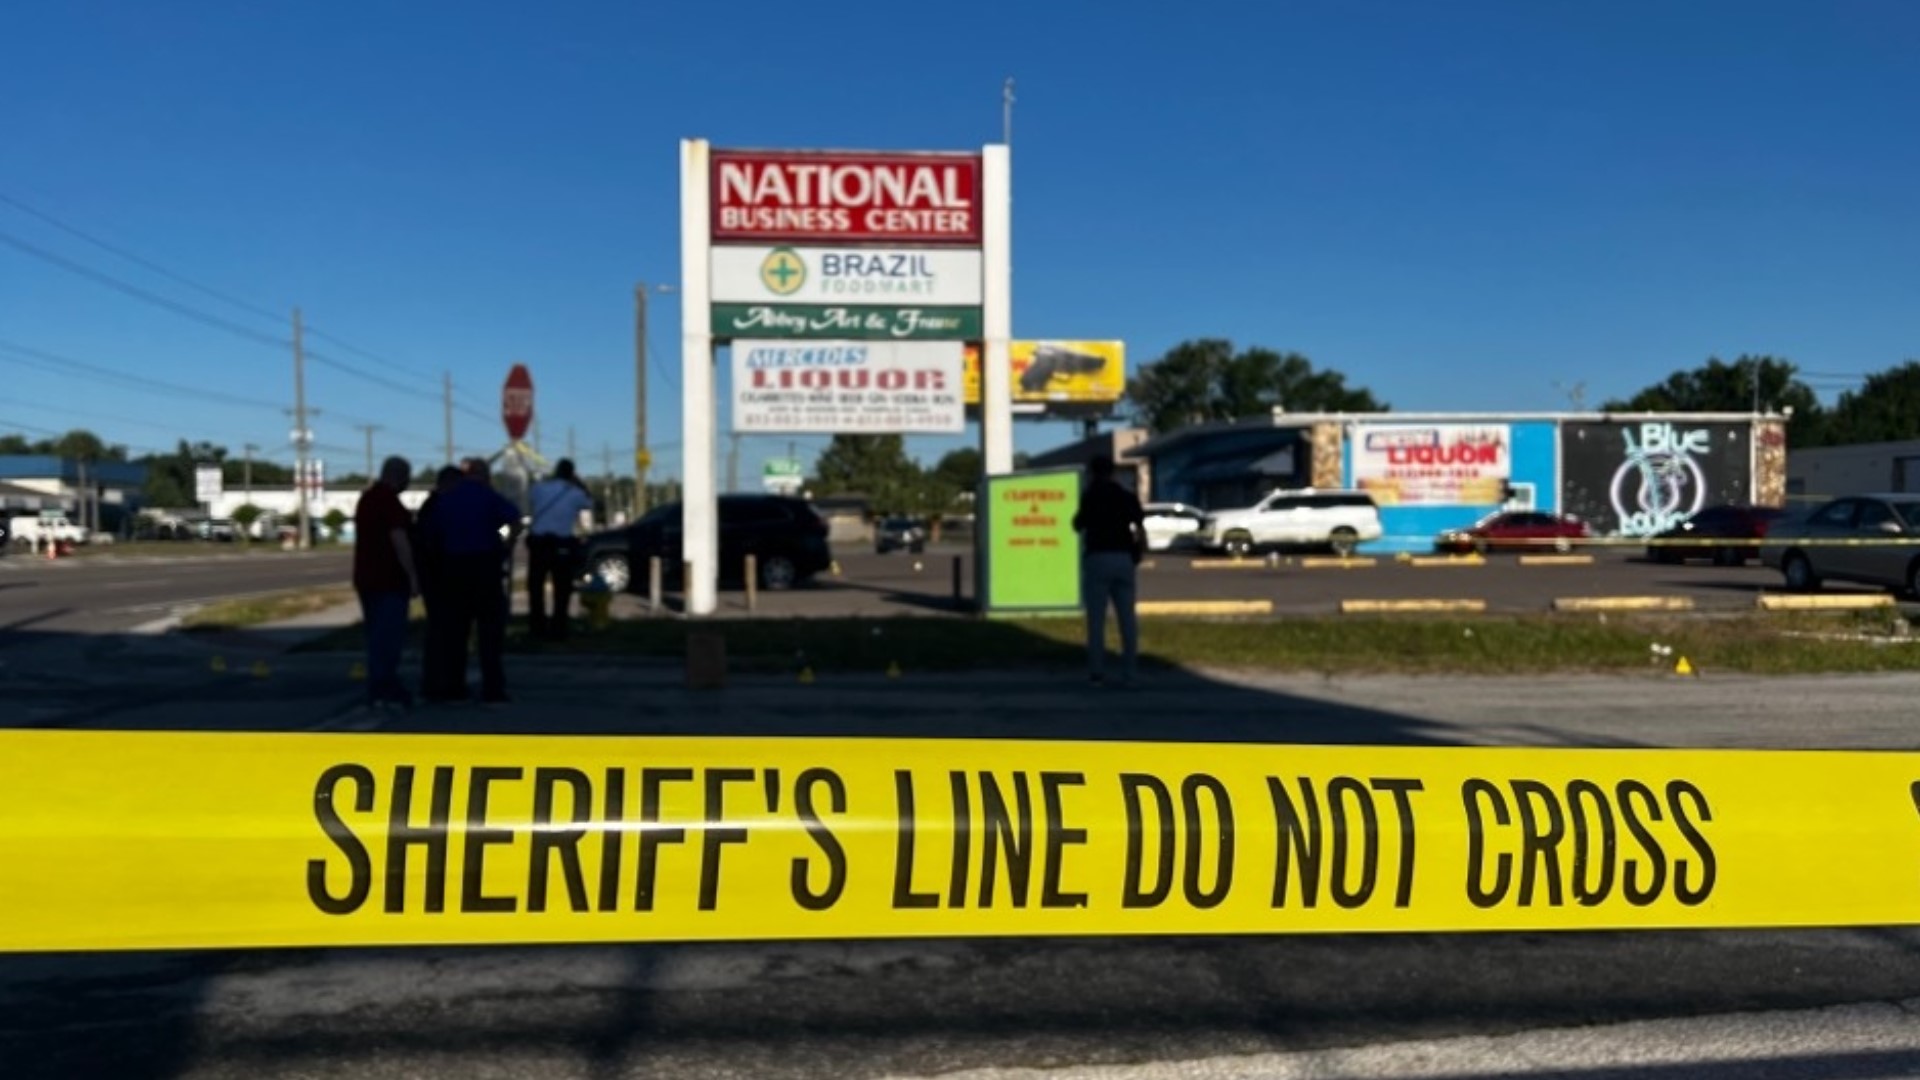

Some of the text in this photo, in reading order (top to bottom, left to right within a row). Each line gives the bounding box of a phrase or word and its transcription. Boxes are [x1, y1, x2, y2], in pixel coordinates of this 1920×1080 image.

[719, 162, 971, 208] NATIONAL
[720, 207, 970, 233] BUSINESS CENTER
[821, 253, 936, 278] BRAZIL
[821, 279, 935, 295] FOODMART
[732, 307, 806, 330] Abbey
[809, 308, 860, 329] Art
[751, 368, 947, 392] LIQUOR
[1639, 422, 1711, 454] Blue
[1386, 443, 1498, 465] LIQUOR
[306, 763, 1717, 915] SHERIFF'S LINE DO NOT CROSS
